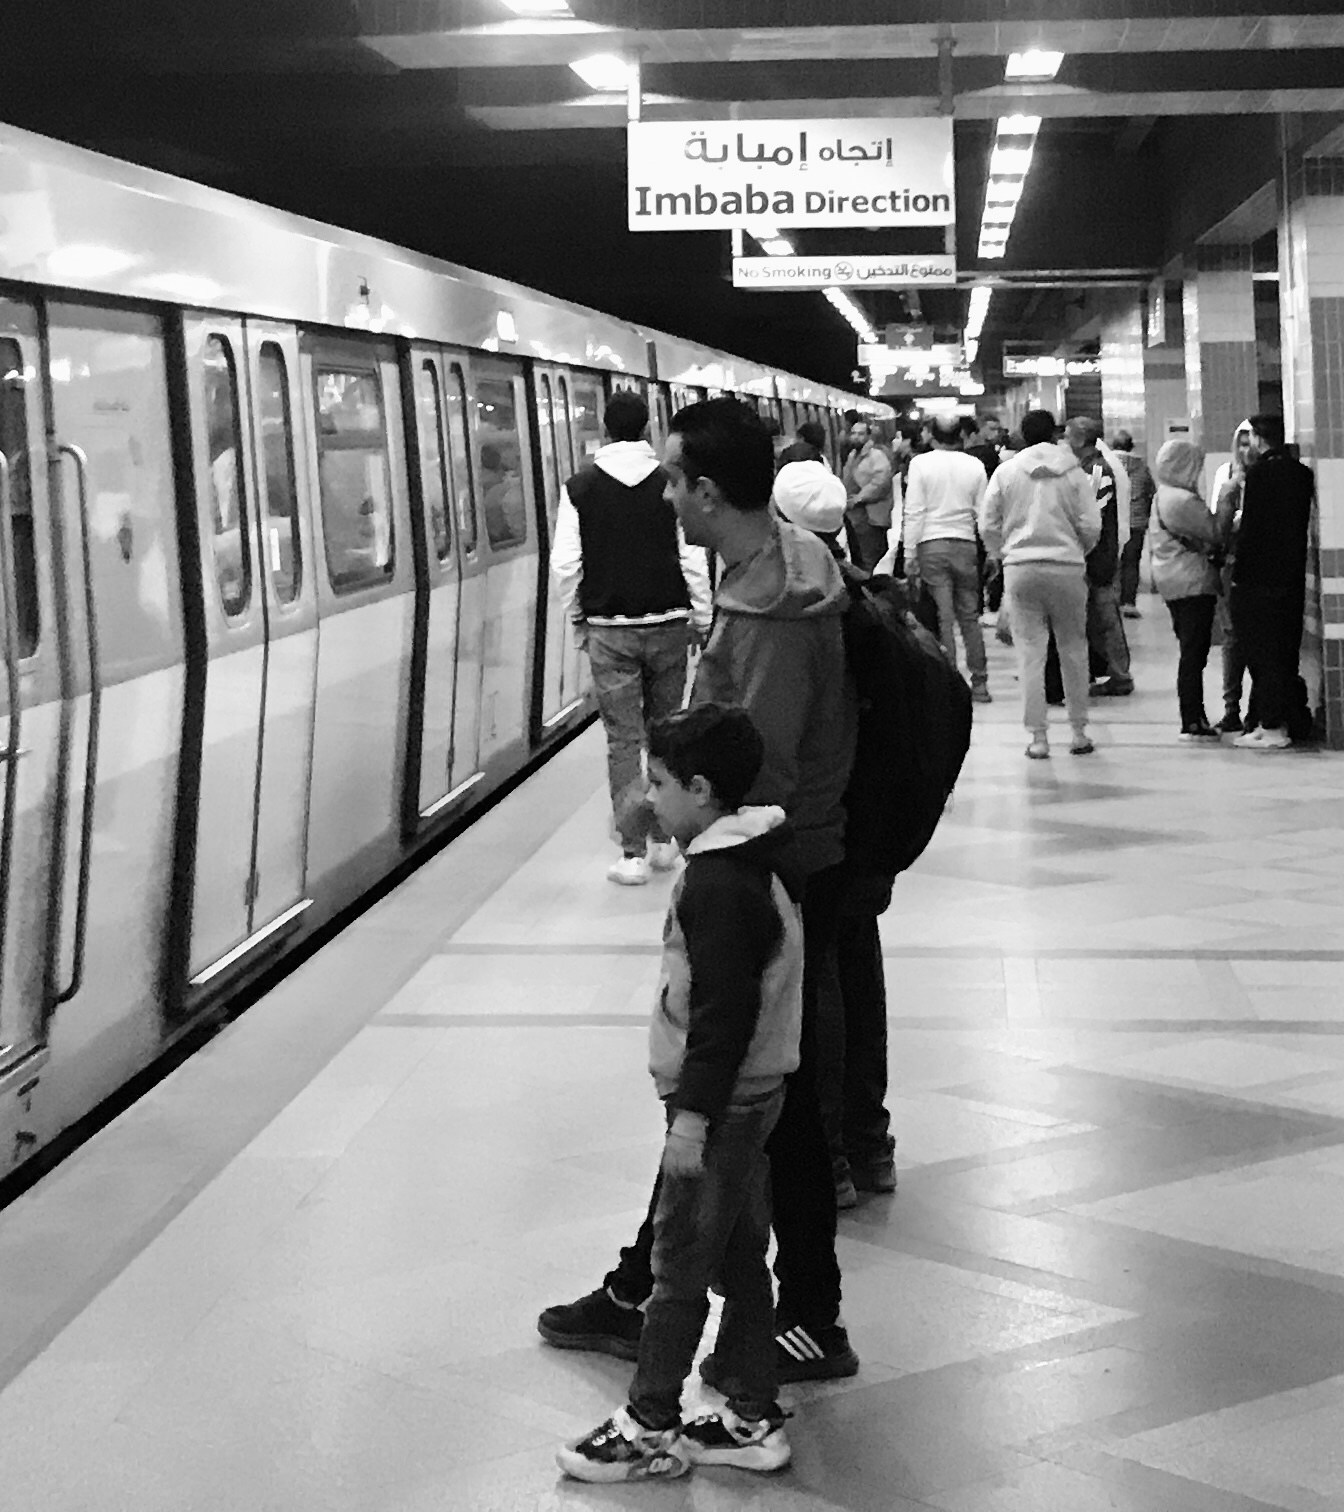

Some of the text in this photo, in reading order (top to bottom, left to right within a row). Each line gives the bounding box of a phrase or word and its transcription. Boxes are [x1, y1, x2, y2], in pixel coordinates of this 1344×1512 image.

[684, 130, 894, 172] إتجاه إمبابة
[634, 183, 950, 216] Imbaba Direction
[738, 265, 832, 281] No Smoking
